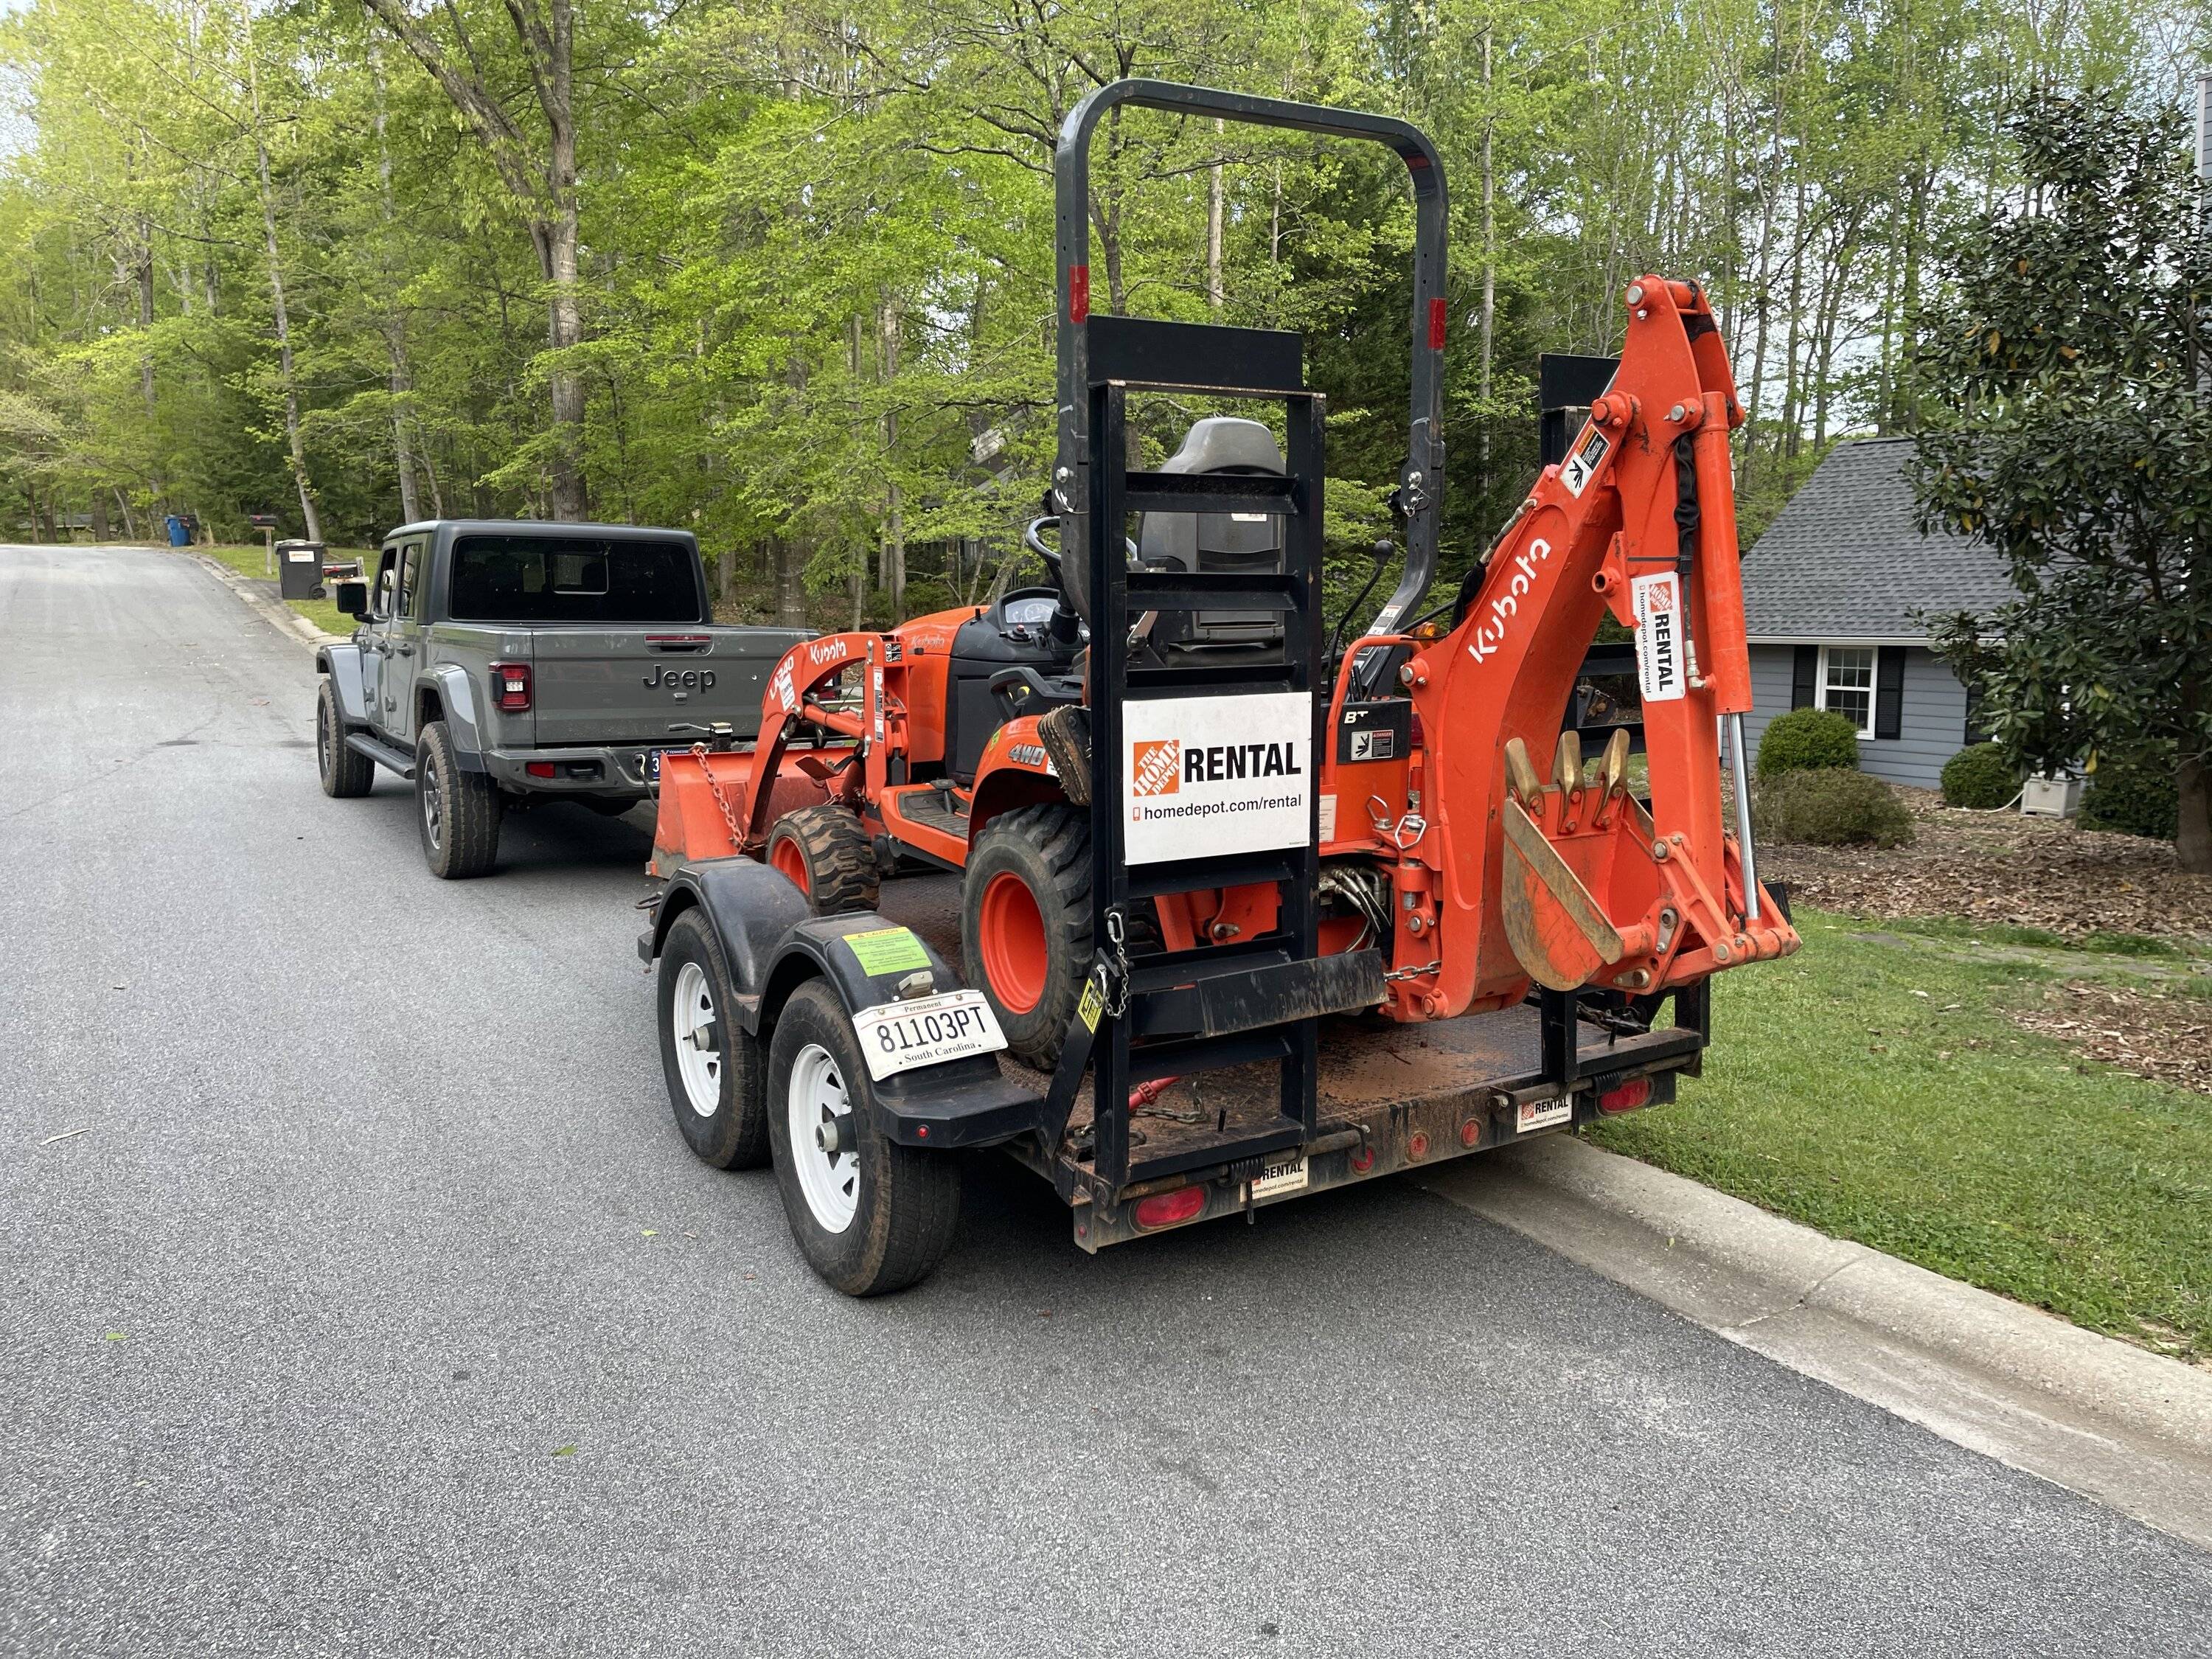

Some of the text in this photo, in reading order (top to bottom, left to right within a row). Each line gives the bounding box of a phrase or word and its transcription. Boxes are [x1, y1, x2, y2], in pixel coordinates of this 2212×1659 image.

[1468, 538, 1552, 664] Kubota
[810, 637, 847, 665] Kubota
[1639, 592, 1652, 694] homedepot.com/rental
[1655, 613, 1674, 692] RENTAL
[641, 664, 716, 694] Jeep
[1008, 742, 1046, 767] 4WD
[1133, 740, 1180, 796] HOME
[1137, 746, 1158, 770] THE
[1184, 742, 1301, 783] RENTAL
[1152, 759, 1180, 796] DEPOT
[1144, 794, 1301, 820] homedepot.com/rental
[904, 1001, 942, 1012] Permanent
[877, 1006, 986, 1053] 81103PT
[904, 1043, 976, 1062] South Carolina
[1535, 1098, 1568, 1114] RENTAL
[1262, 1163, 1304, 1181] RENTAL
